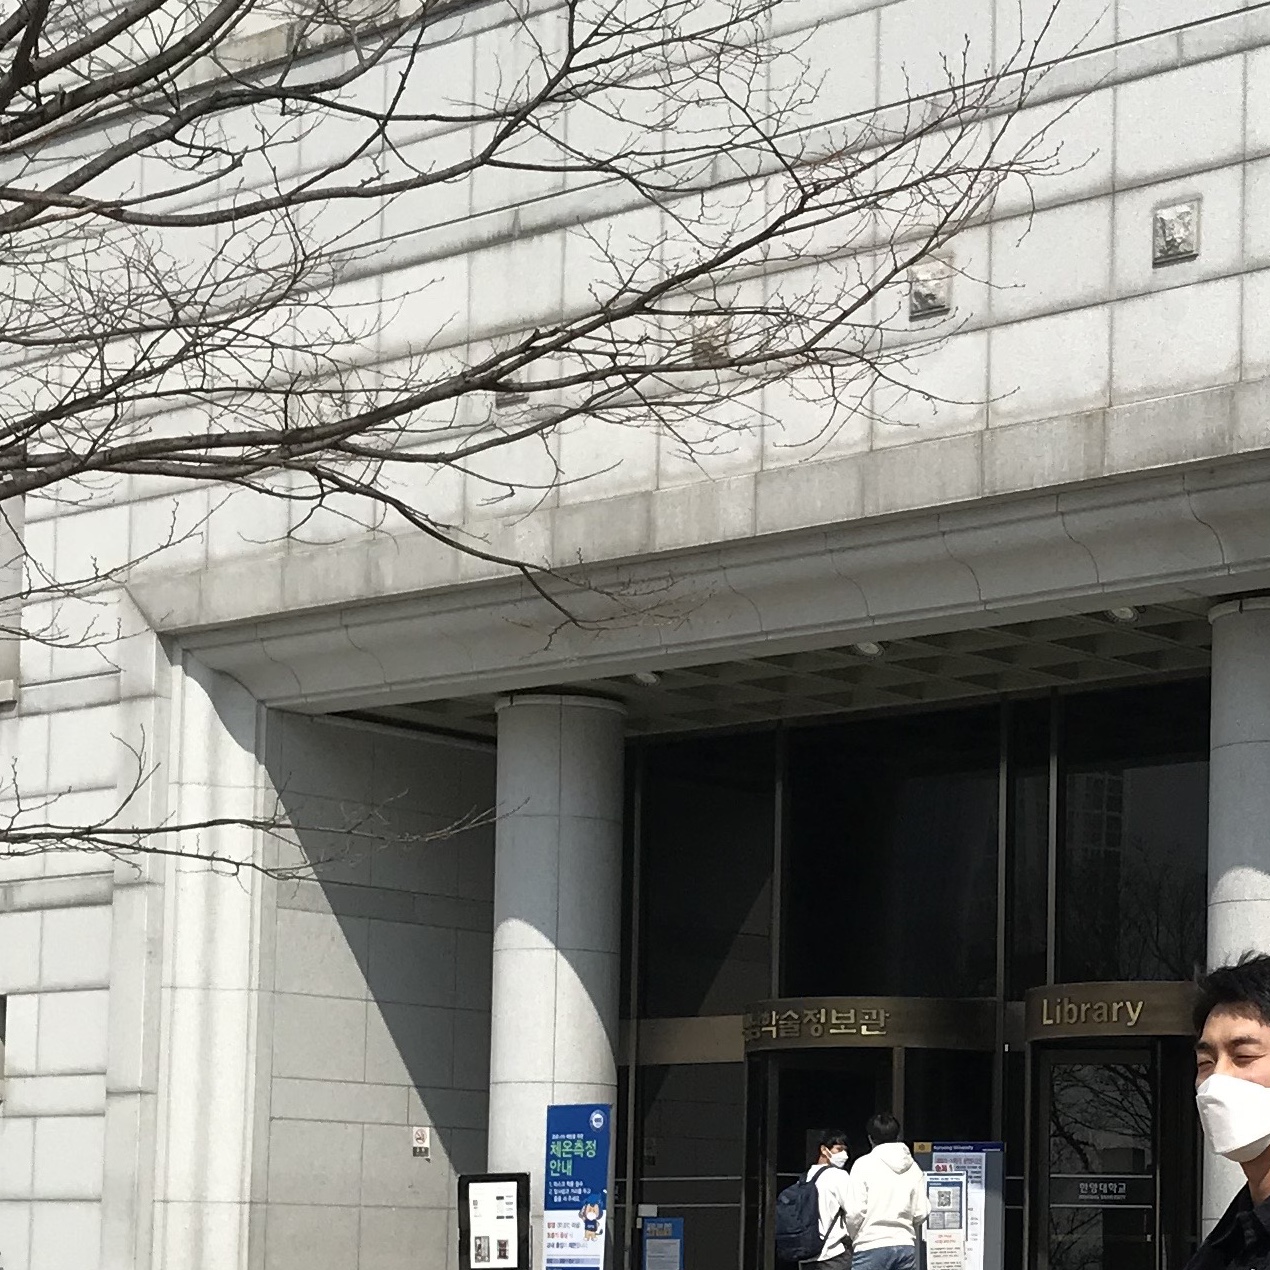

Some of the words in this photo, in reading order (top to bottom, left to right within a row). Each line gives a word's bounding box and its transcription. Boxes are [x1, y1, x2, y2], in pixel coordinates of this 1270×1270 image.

[1043, 998, 1143, 1026] Library
[744, 1008, 890, 1040] 학술정보관
[550, 1140, 597, 1158] 체온측정
[550, 1160, 573, 1176] 안내
[1080, 1183, 1126, 1193] 한양대학교
